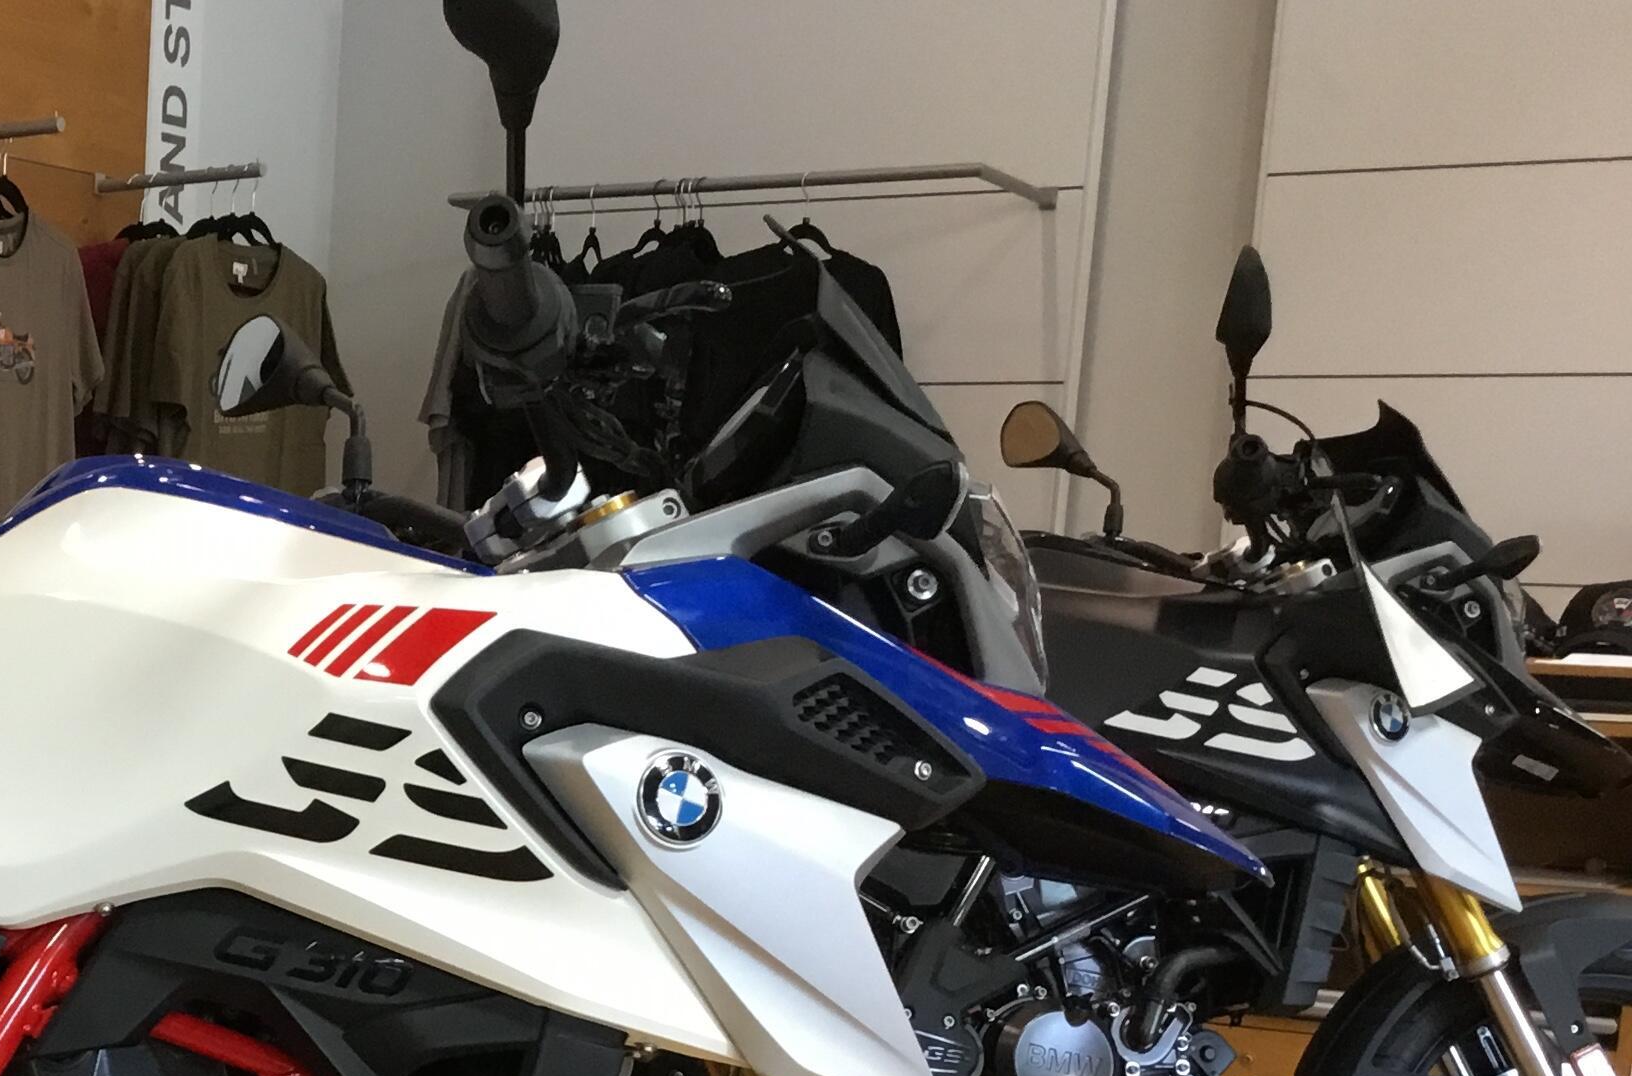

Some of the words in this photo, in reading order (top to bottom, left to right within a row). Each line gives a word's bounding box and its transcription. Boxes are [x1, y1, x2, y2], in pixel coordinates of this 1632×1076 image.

[159, 85, 188, 225] AND
[214, 926, 290, 972] G
[286, 941, 414, 997] 310
